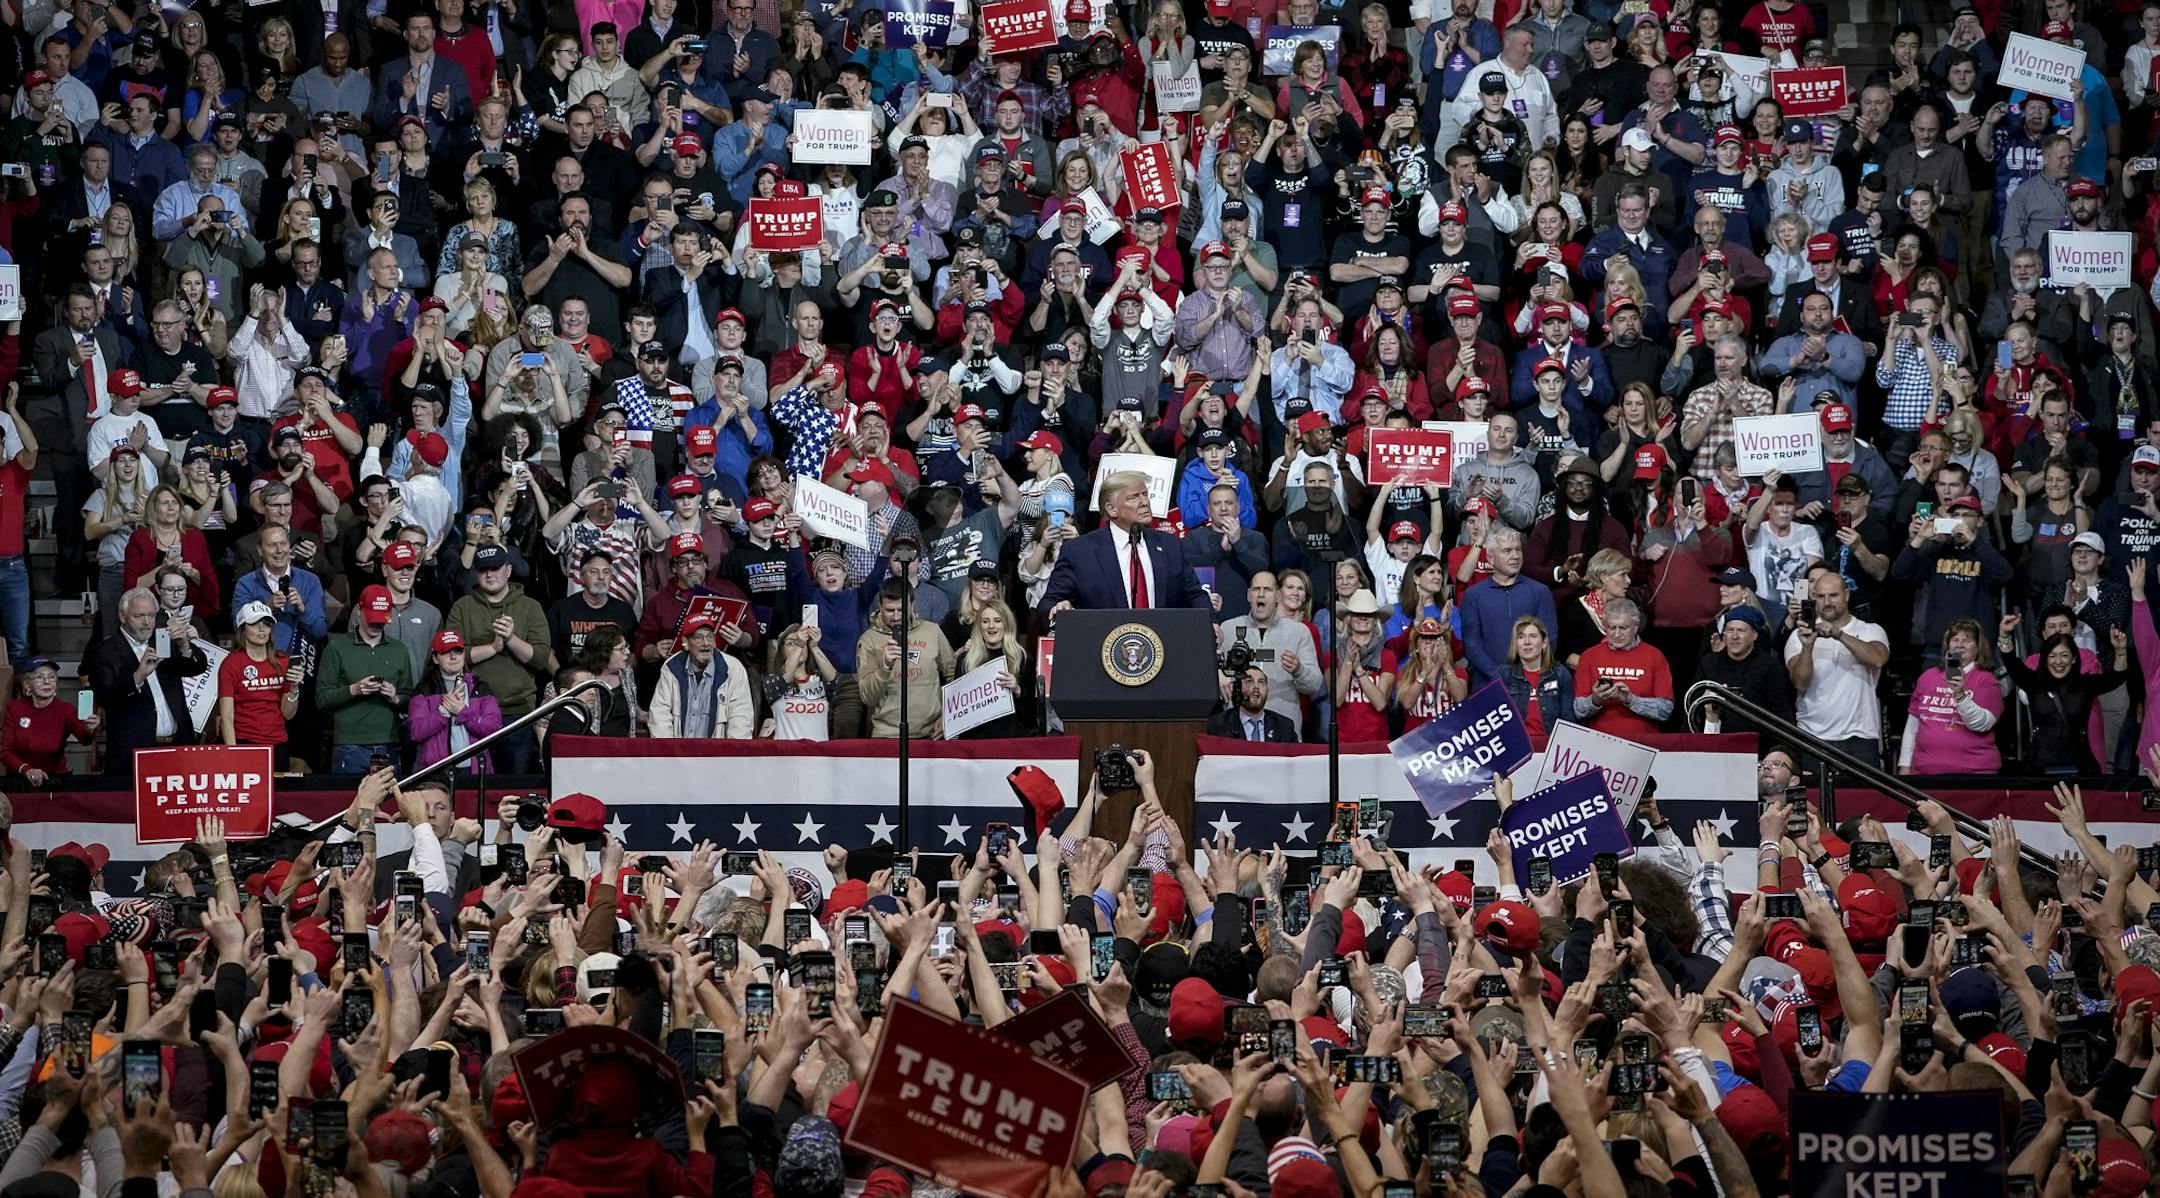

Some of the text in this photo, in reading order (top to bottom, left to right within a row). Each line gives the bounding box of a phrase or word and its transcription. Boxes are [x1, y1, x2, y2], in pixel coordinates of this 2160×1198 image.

[888, 11, 951, 26] PROMISES
[987, 10, 1048, 29] TRUMP
[903, 25, 937, 37] KEPT
[994, 21, 1045, 35] PENCE
[1761, 23, 1795, 31] WOMEN
[1761, 36, 1796, 44] TRUMP
[2010, 46, 2074, 79] Women
[1157, 74, 1198, 90] Women
[2013, 67, 2065, 85] FOR TRUMP
[1777, 80, 1841, 93] TRUMP
[1175, 91, 1195, 99] TRUMP
[1783, 90, 1836, 99] PENCE
[799, 122, 865, 143] Women
[806, 142, 859, 151] FOR TRUMP
[1136, 152, 1156, 203] PENCE
[1142, 146, 1166, 204] TRUMP
[782, 184, 799, 194] USA
[1704, 192, 1745, 205] TRUMP
[754, 211, 818, 224] TRUMP
[760, 222, 813, 232] PENCE
[2054, 245, 2124, 265] Women
[2062, 265, 2116, 274] FOR TRUMP
[1375, 443, 1447, 457] TRUMP
[1740, 432, 1813, 453] Women
[1381, 455, 1439, 465] PENCE
[1749, 450, 1806, 461] FOR TRUMP
[801, 488, 864, 527] Women
[829, 517, 858, 532] TRUMP
[2120, 517, 2158, 529] POLIC
[2120, 534, 2160, 545] TRUMP
[2132, 544, 2150, 552] 2020
[197, 658, 216, 694] TRUMP
[1596, 666, 1645, 677] TRUMP
[242, 677, 285, 688] TRUMP
[947, 680, 1003, 713] Women
[1922, 696, 1956, 707] TRUM
[785, 702, 825, 714] 2020
[953, 696, 1000, 721] FOR TRUMP
[1408, 702, 1513, 777] PROMISES
[1440, 735, 1507, 784] MADE
[146, 773, 261, 793] TRUMP
[156, 791, 250, 806] PENCE
[165, 807, 181, 815] KEEP
[1509, 795, 1608, 849] ROMISES
[1532, 827, 1588, 860] KEPT
[894, 1043, 1067, 1142] TRUMP
[898, 1082, 1045, 1157] PENCE
[906, 1109, 936, 1132] KEEP
[936, 1118, 982, 1151] AMERICA
[1797, 1131, 1996, 1164] PROMISES
[1845, 1171, 1947, 1198] KEPT
